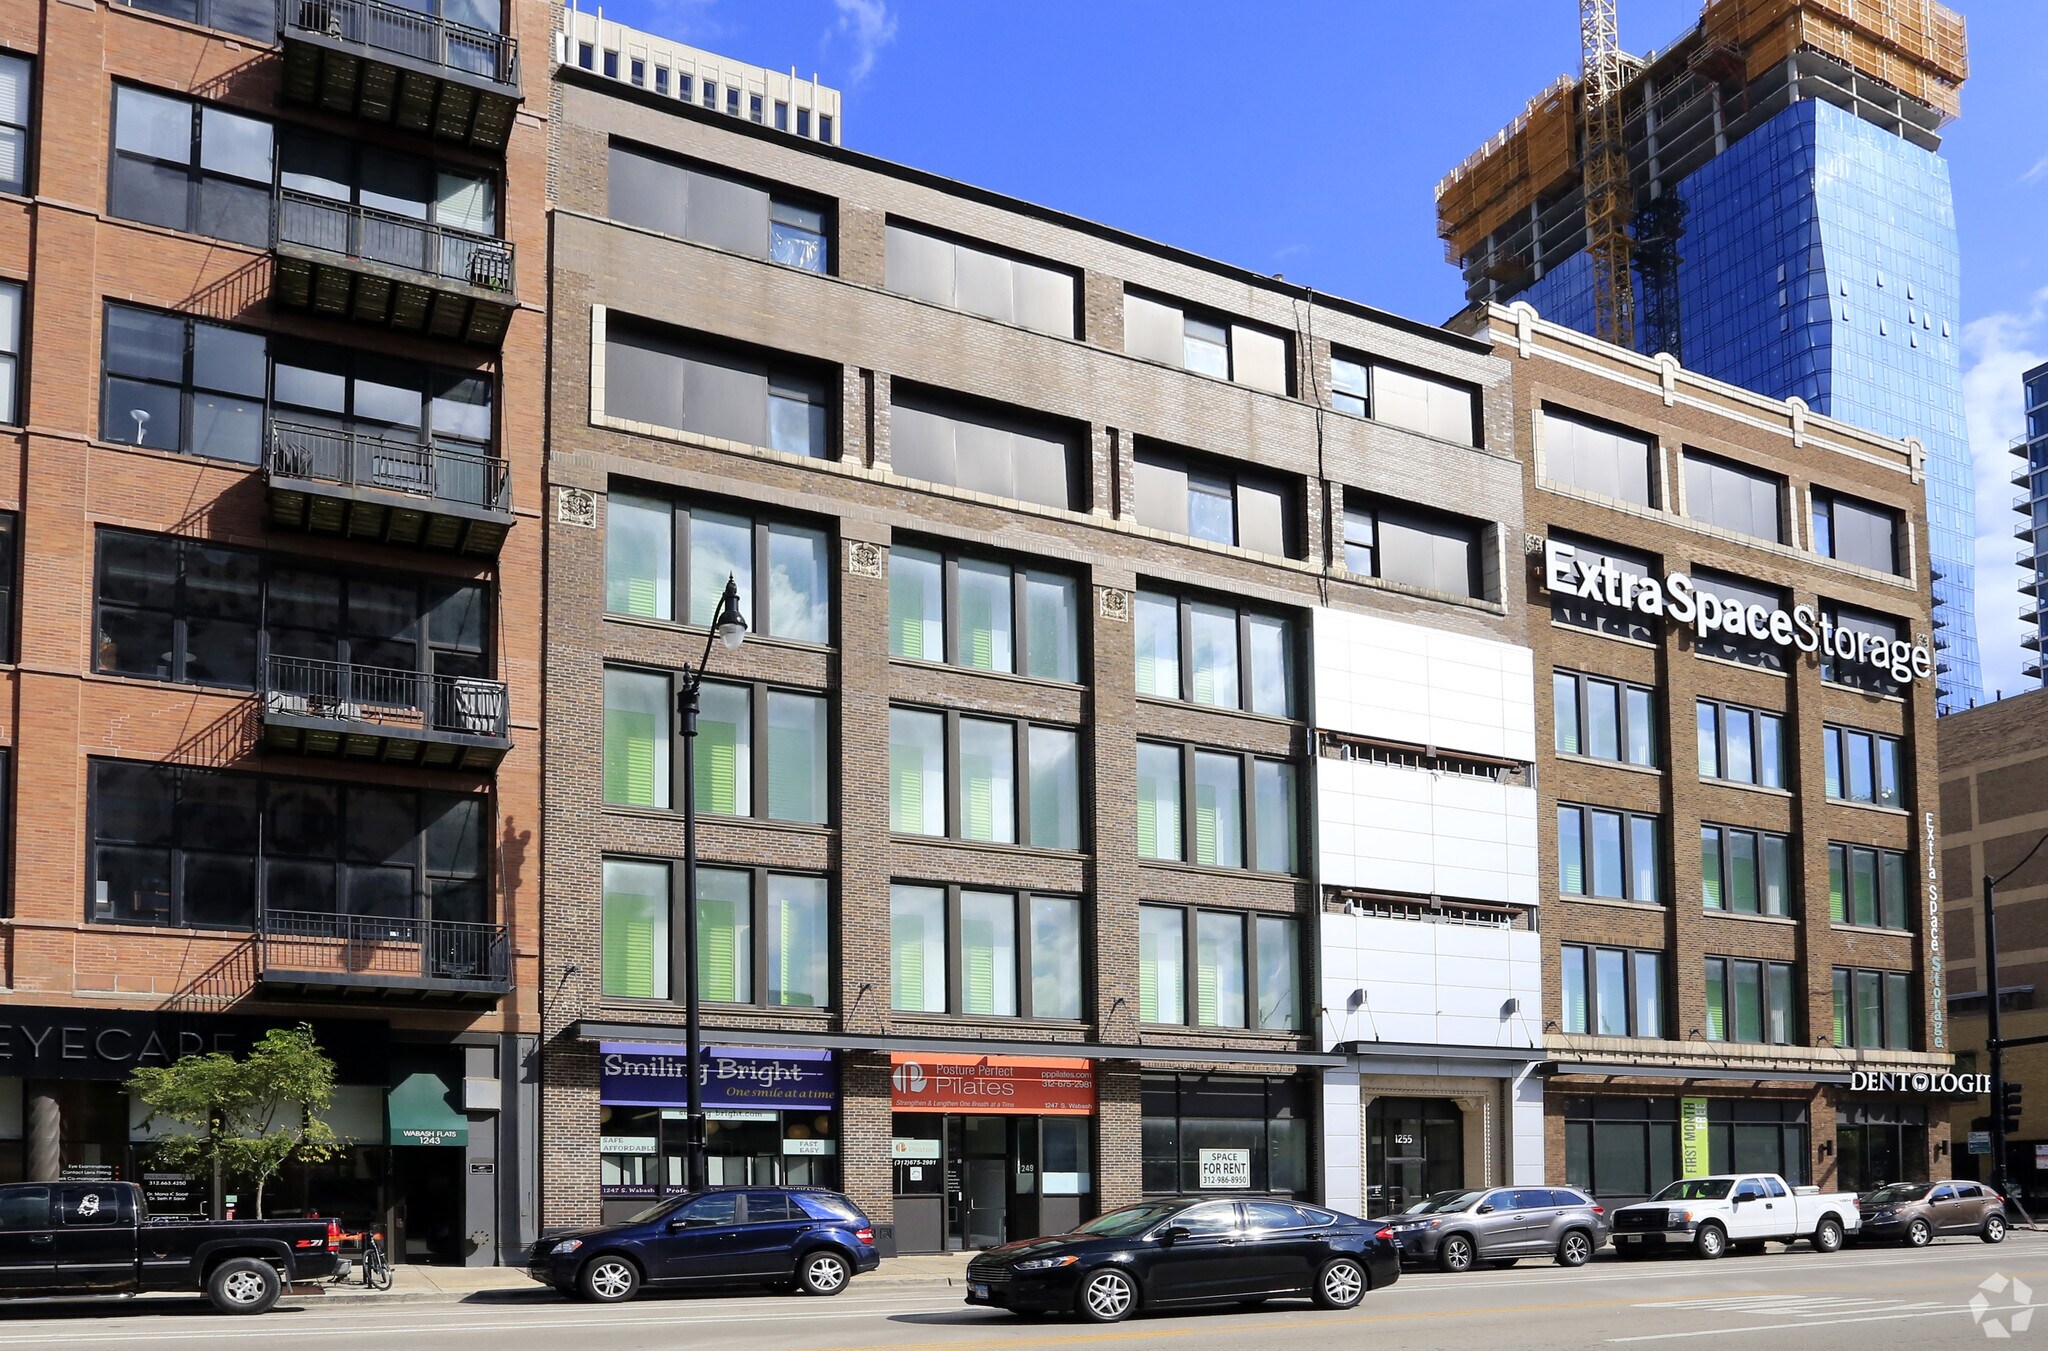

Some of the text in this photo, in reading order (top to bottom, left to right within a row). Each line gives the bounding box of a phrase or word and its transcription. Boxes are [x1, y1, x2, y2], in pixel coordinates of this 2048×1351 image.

[1925, 812, 1944, 1049] Extra Space Storage
[716, 1058, 803, 1088] Bright
[936, 1064, 1014, 1077] Posture Perfect
[936, 1076, 1015, 1096] Pilates
[1041, 1079, 1092, 1088] 312-675-2981
[726, 1087, 750, 1097] One
[752, 1087, 783, 1098] smile
[784, 1089, 797, 1099] at
[808, 1089, 835, 1099] time
[896, 1099, 926, 1107] Strengthen
[933, 1101, 959, 1109] Lengthen
[1695, 1103, 1707, 1130] FREE
[419, 1136, 441, 1145] 1243
[1395, 1134, 1413, 1144] 1255
[1684, 1102, 1697, 1174] FIRST MONTH
[1211, 1153, 1238, 1161] SPACE
[1203, 1163, 1246, 1174] FOR RENT
[1203, 1176, 1247, 1184] 312-986-8950
[295, 1239, 323, 1247] Z71
